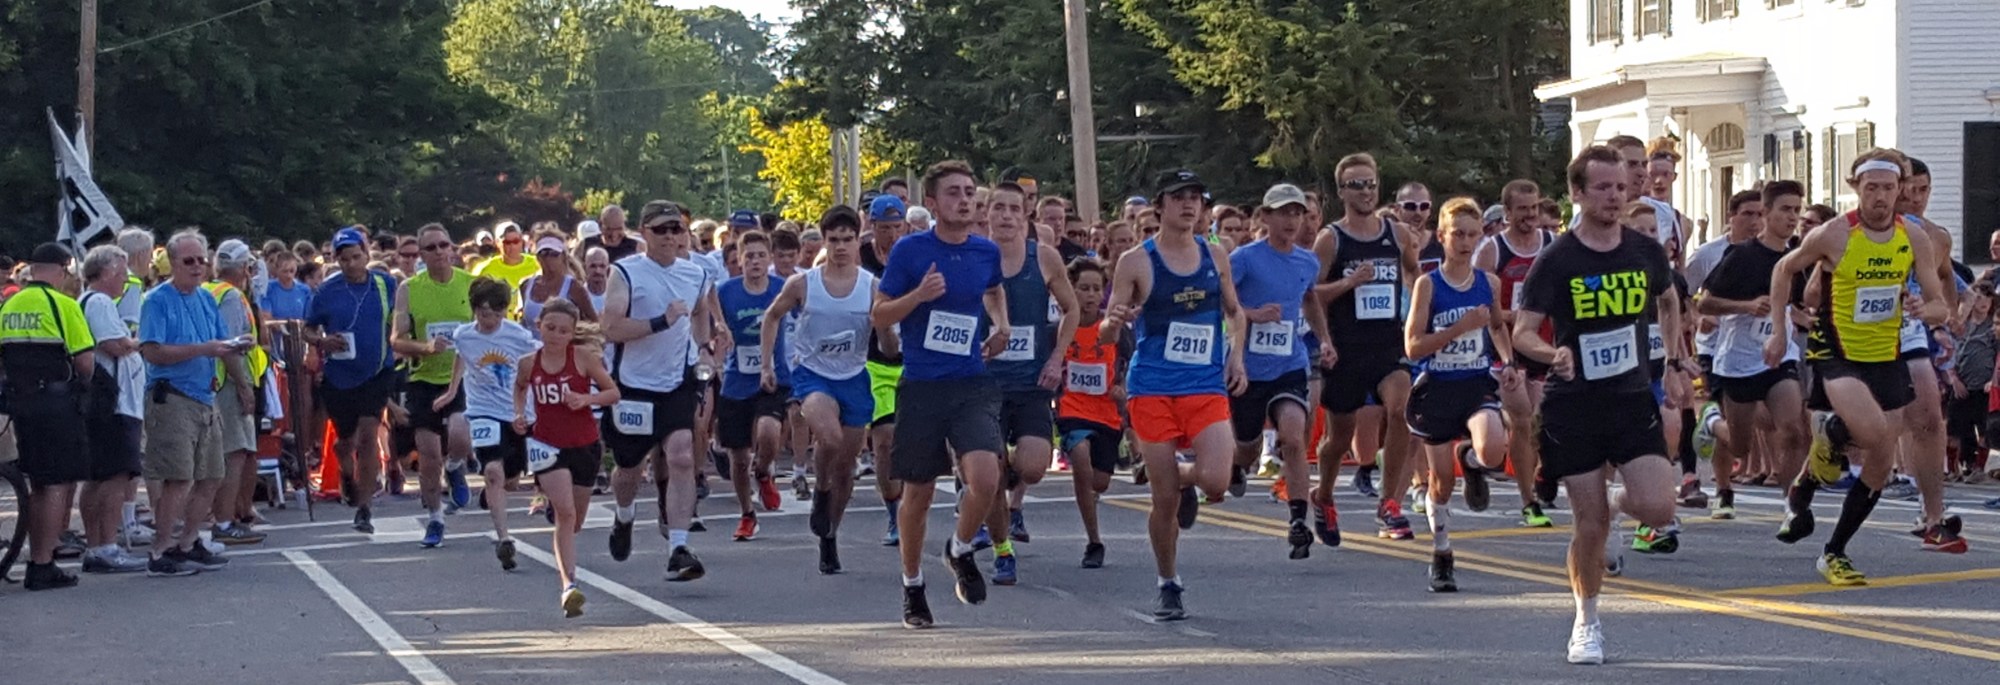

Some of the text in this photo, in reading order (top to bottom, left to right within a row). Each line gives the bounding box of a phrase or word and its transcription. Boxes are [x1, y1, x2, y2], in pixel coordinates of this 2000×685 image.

[1868, 258, 1892, 267] new
[1856, 270, 1904, 280] balance
[1361, 296, 1391, 310] 1092
[1573, 288, 1646, 319] END
[1860, 299, 1894, 314] 2630
[2, 312, 43, 331] POLICE
[932, 325, 970, 346] 2885
[1255, 332, 1287, 346] 2165
[1171, 336, 1208, 354] 2918
[1589, 343, 1630, 367] 1971
[1071, 372, 1102, 388] 2438
[535, 383, 572, 405] USA
